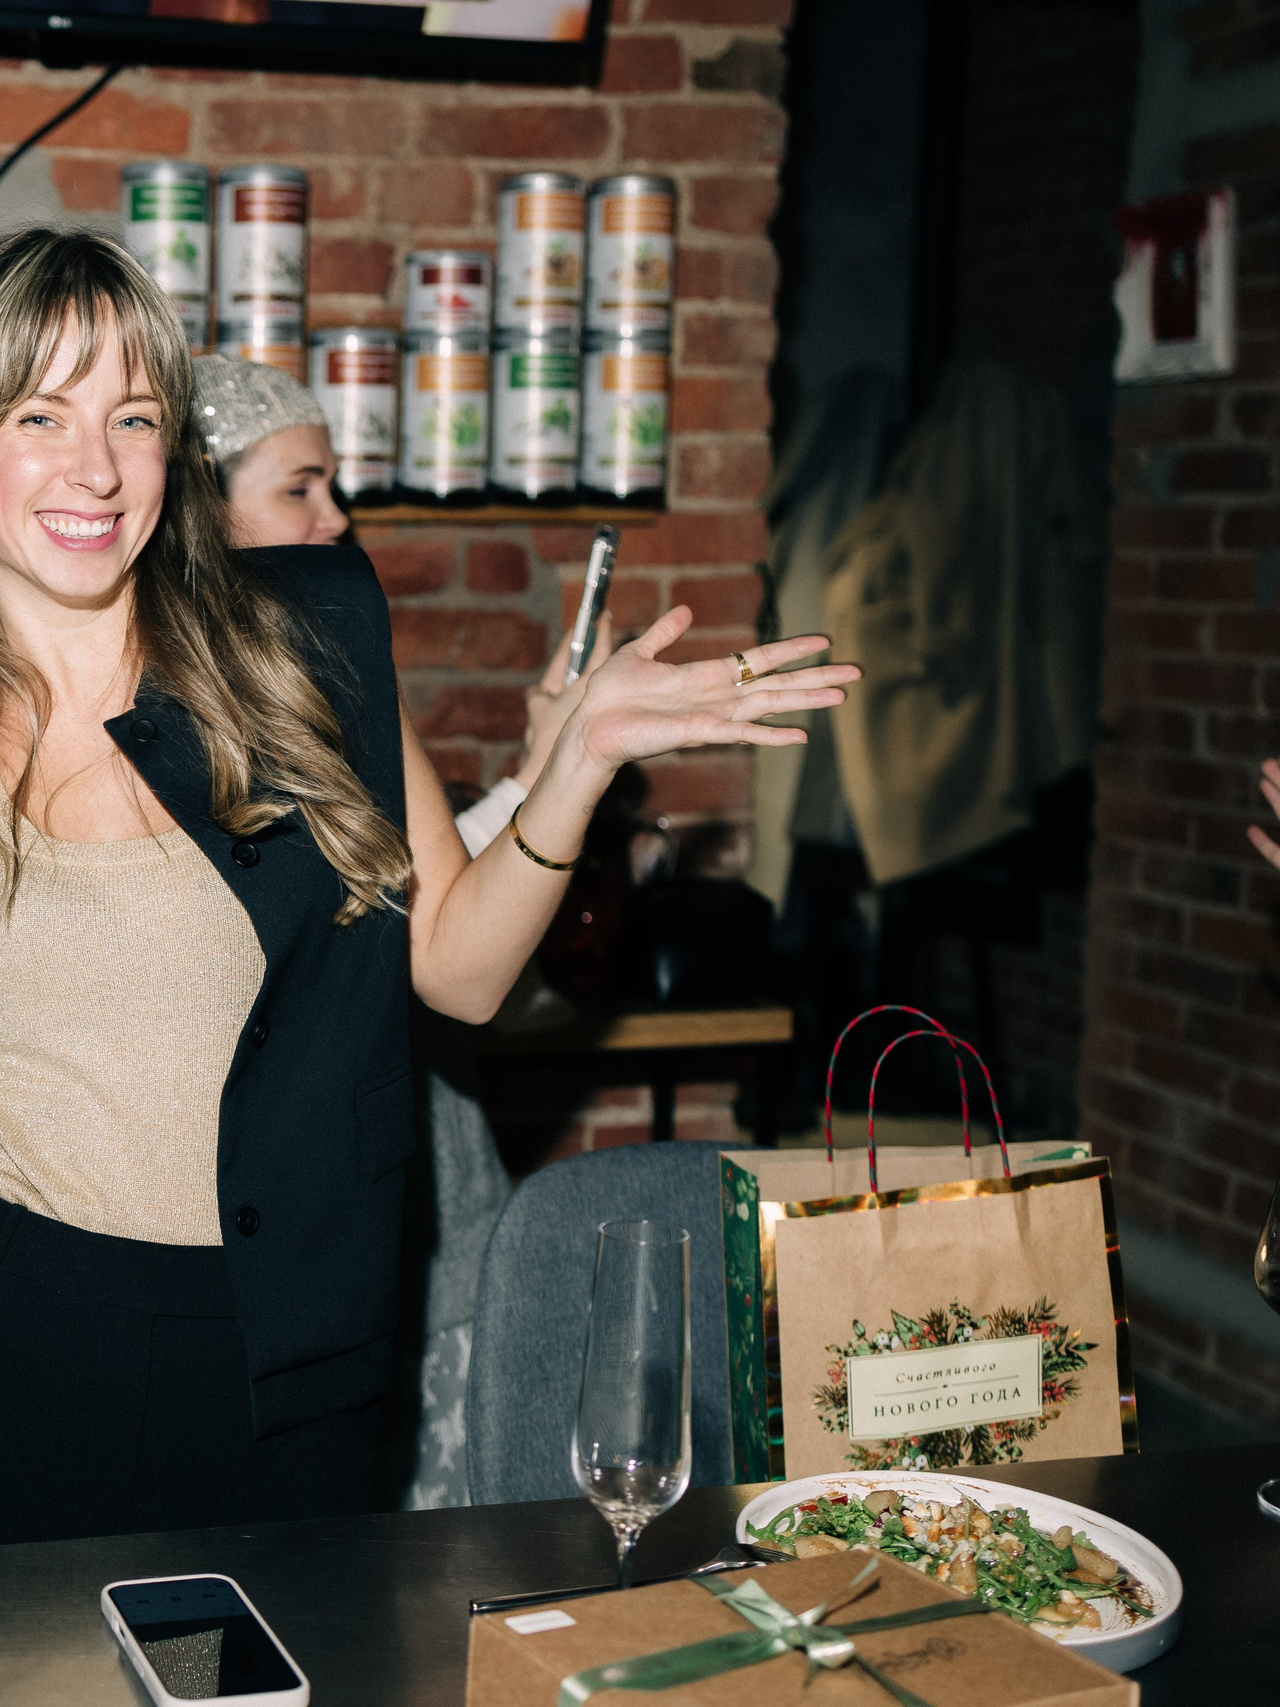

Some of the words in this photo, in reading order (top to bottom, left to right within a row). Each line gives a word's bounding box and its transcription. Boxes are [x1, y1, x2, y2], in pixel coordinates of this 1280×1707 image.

[895, 1362, 997, 1384] Счастливого
[874, 1395, 959, 1418] НОВОГО
[970, 1386, 1022, 1405] ГОДА
